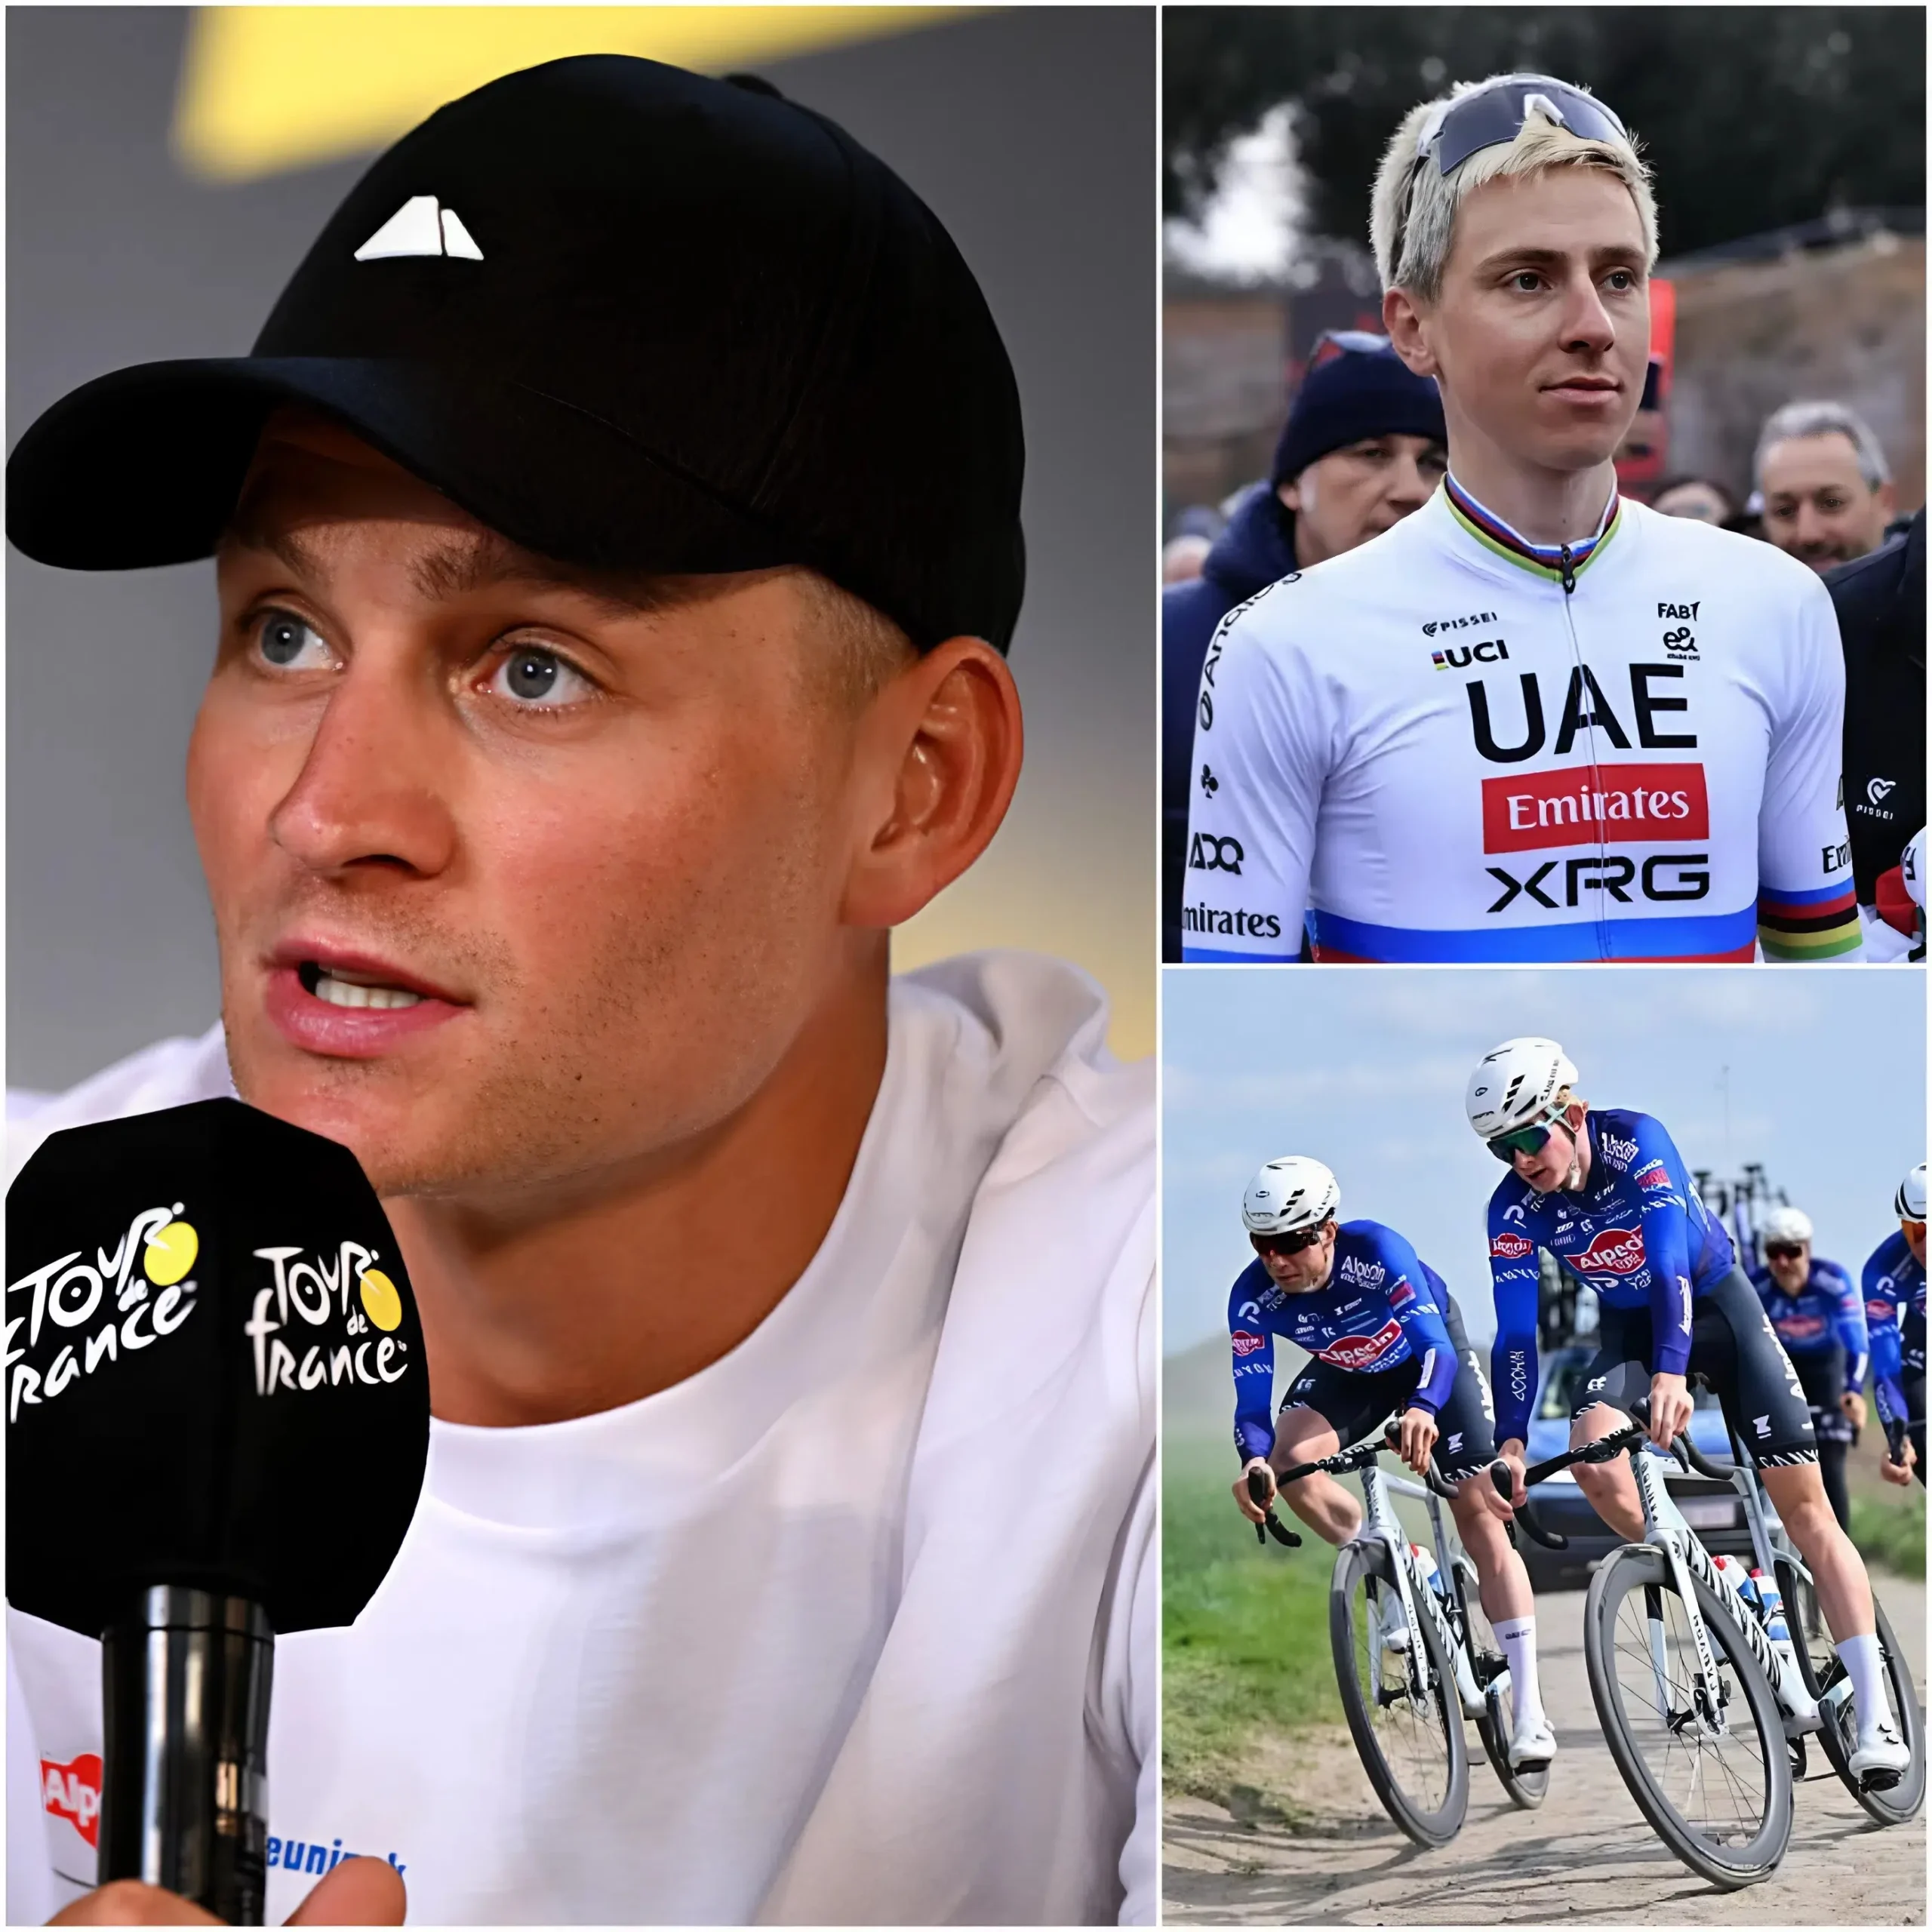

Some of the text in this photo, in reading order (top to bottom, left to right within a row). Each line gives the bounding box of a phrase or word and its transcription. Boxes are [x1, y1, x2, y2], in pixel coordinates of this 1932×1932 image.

[1441, 611, 1497, 632] PISSEI
[1444, 639, 1509, 668] UCI
[1466, 663, 1698, 764] UAE
[1506, 785, 1690, 830] Emirates
[1189, 832, 1244, 875] ADQ
[1484, 854, 1710, 914] XRG
[346, 1304, 368, 1336] de
[45, 1768, 102, 1828] Alp
